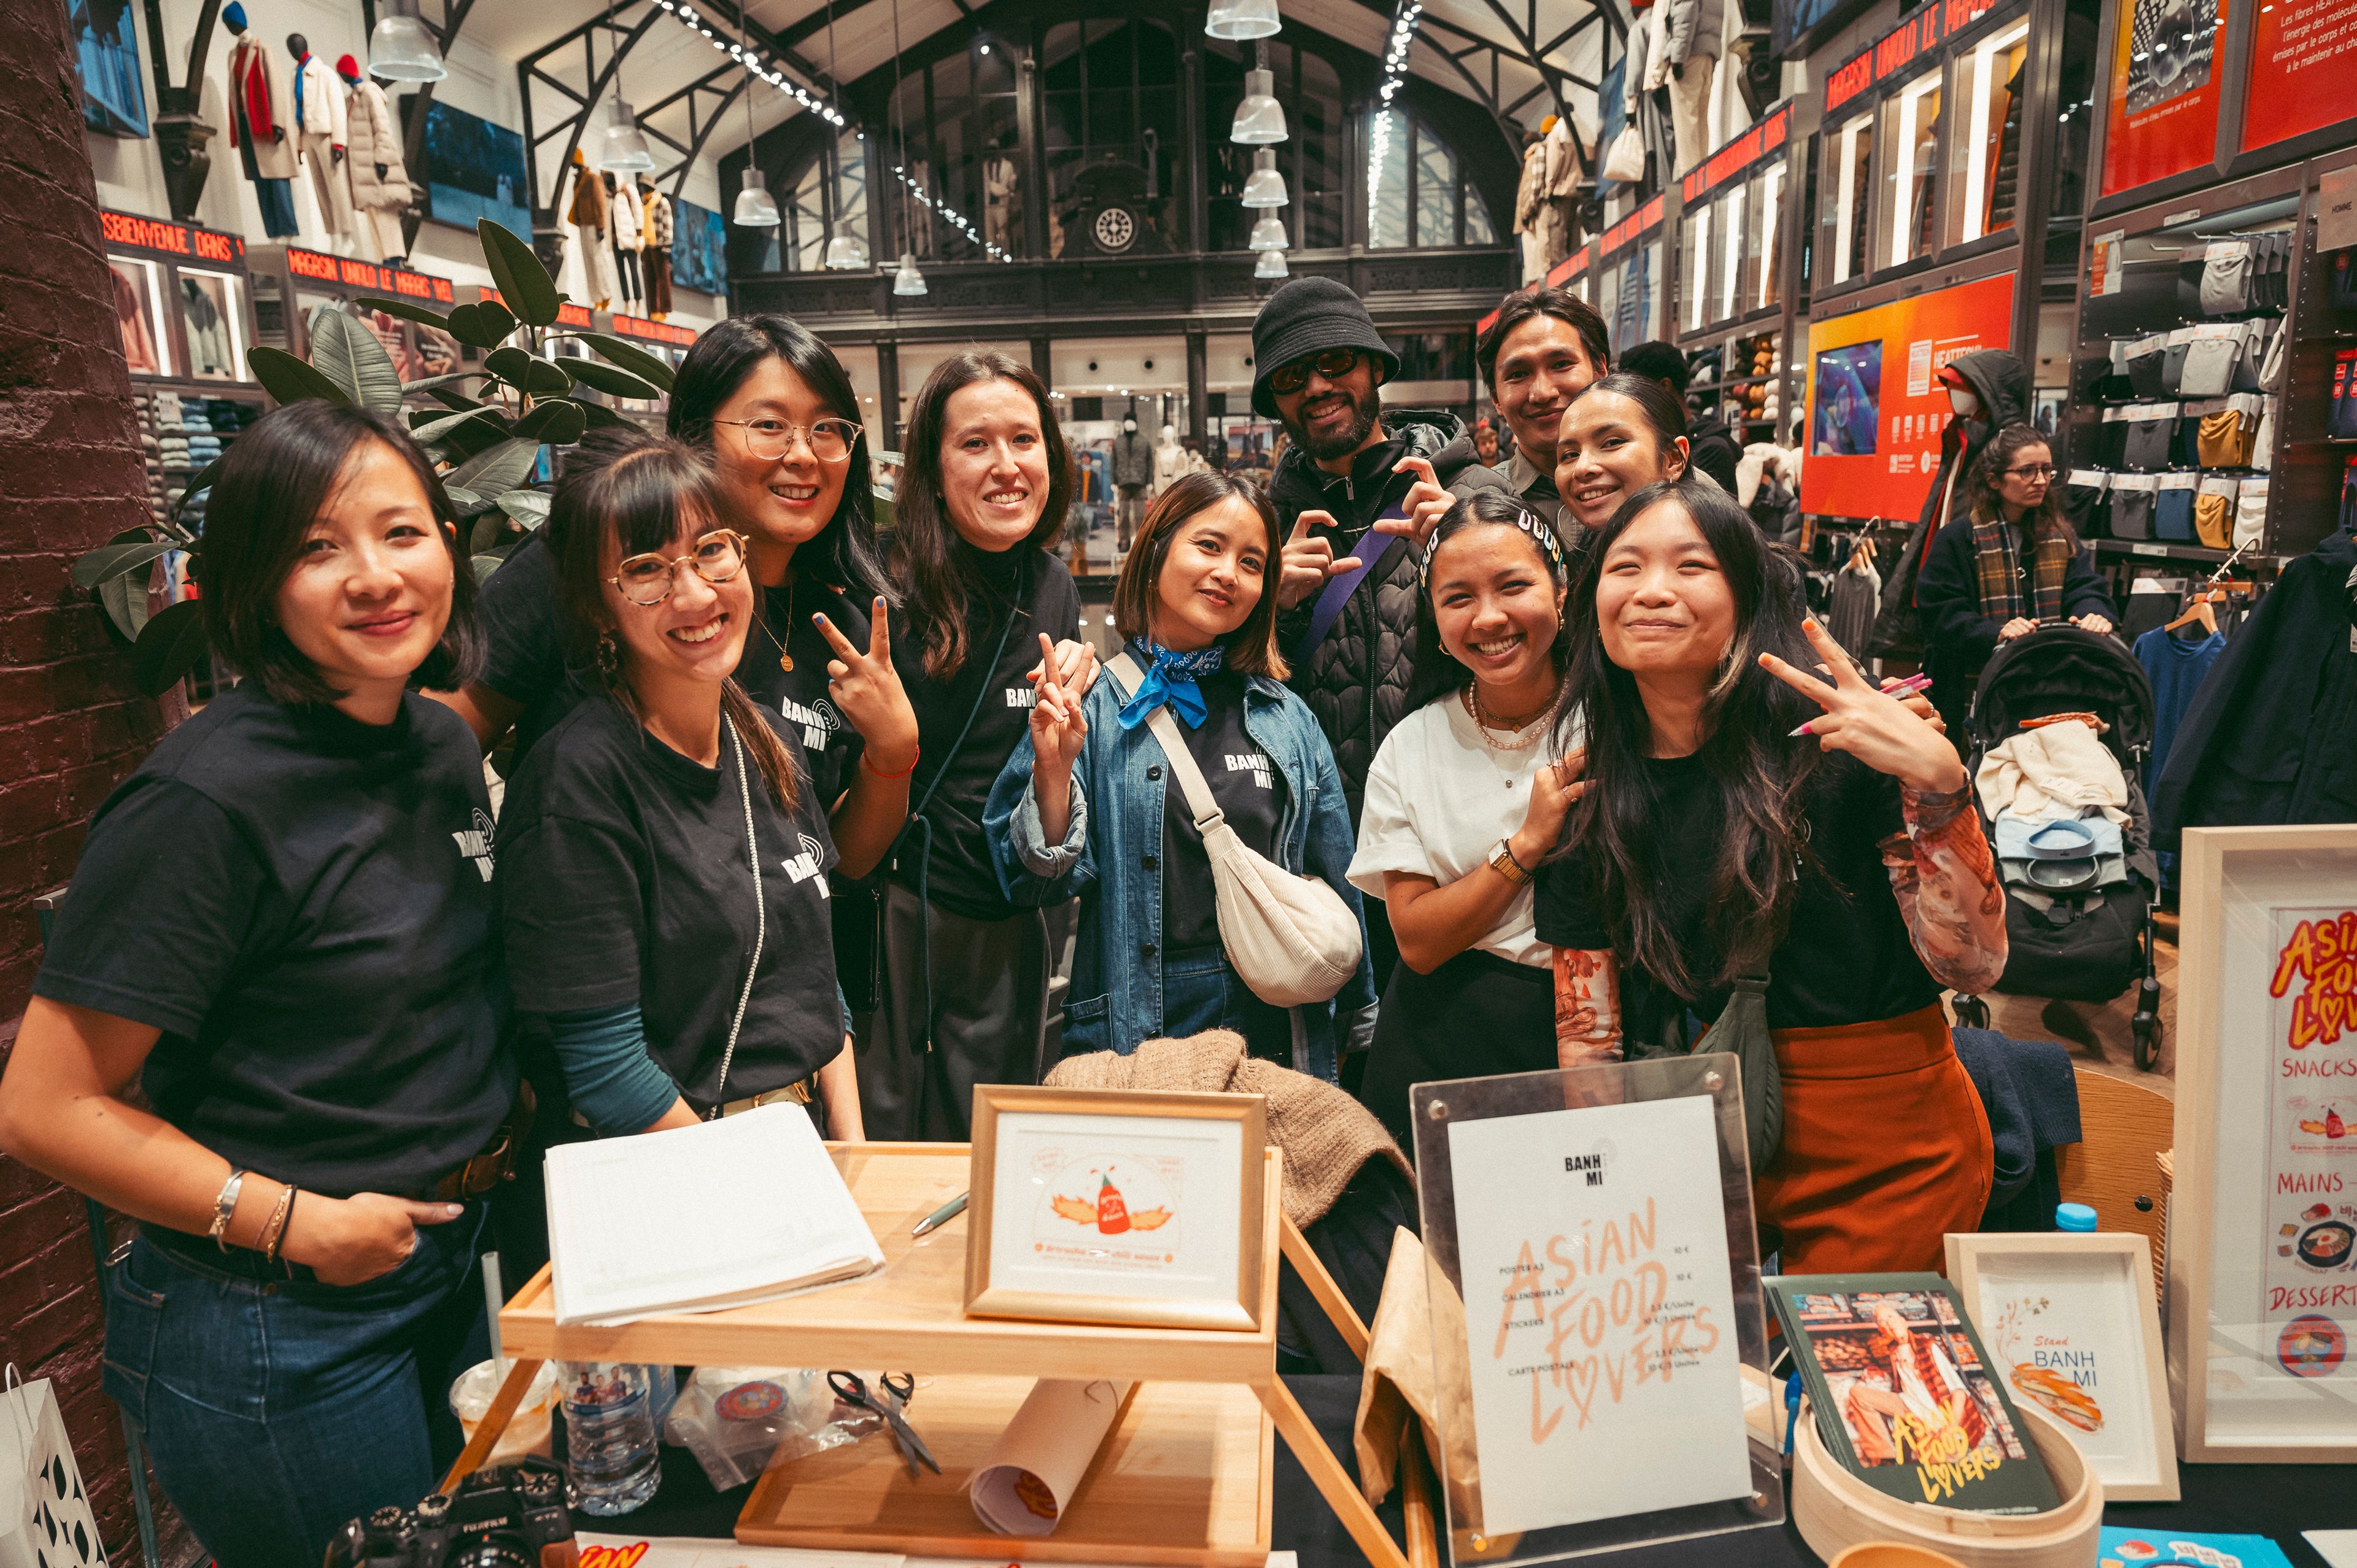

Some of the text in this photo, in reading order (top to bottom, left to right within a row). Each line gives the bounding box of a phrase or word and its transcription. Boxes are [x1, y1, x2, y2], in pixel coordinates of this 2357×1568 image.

[2281, 14, 2293, 27] Les
[2295, 6, 2313, 21] fibres
[1922, 3, 1939, 52] LE
[2283, 22, 2311, 42] l'énergie
[2312, 17, 2324, 29] des
[2272, 46, 2295, 63] émises
[2296, 41, 2308, 56] par
[2310, 36, 2316, 47] le
[2318, 29, 2337, 42] corps
[2340, 22, 2347, 36] et
[2293, 60, 2299, 71] le
[2301, 46, 2334, 68] maintenir
[2335, 43, 2345, 54] au
[194, 230, 233, 263] DANS
[379, 268, 394, 292] LE
[1005, 688, 1039, 707] BAN
[781, 695, 826, 731] BANH
[803, 725, 826, 752] MI
[1224, 754, 1270, 771] BANH
[1253, 770, 1272, 790] MI
[2282, 1057, 2357, 1078] SNACKS
[1565, 1154, 1601, 1172] BANH
[1587, 1171, 1603, 1186] MI
[2278, 1172, 2343, 1195] MAINS
[1499, 1264, 1531, 1275] POSTER
[1501, 1289, 1552, 1302] CALENDRIER
[1504, 1318, 1544, 1330] STICKERS
[1545, 1259, 1668, 1388] FOOD
[2034, 1335, 2069, 1346] Stand
[1508, 1360, 1574, 1377] CARTE POSTALE
[2035, 1350, 2095, 1367] BANH
[2073, 1370, 2097, 1387] MI
[1916, 1425, 1970, 1480] FOOD
